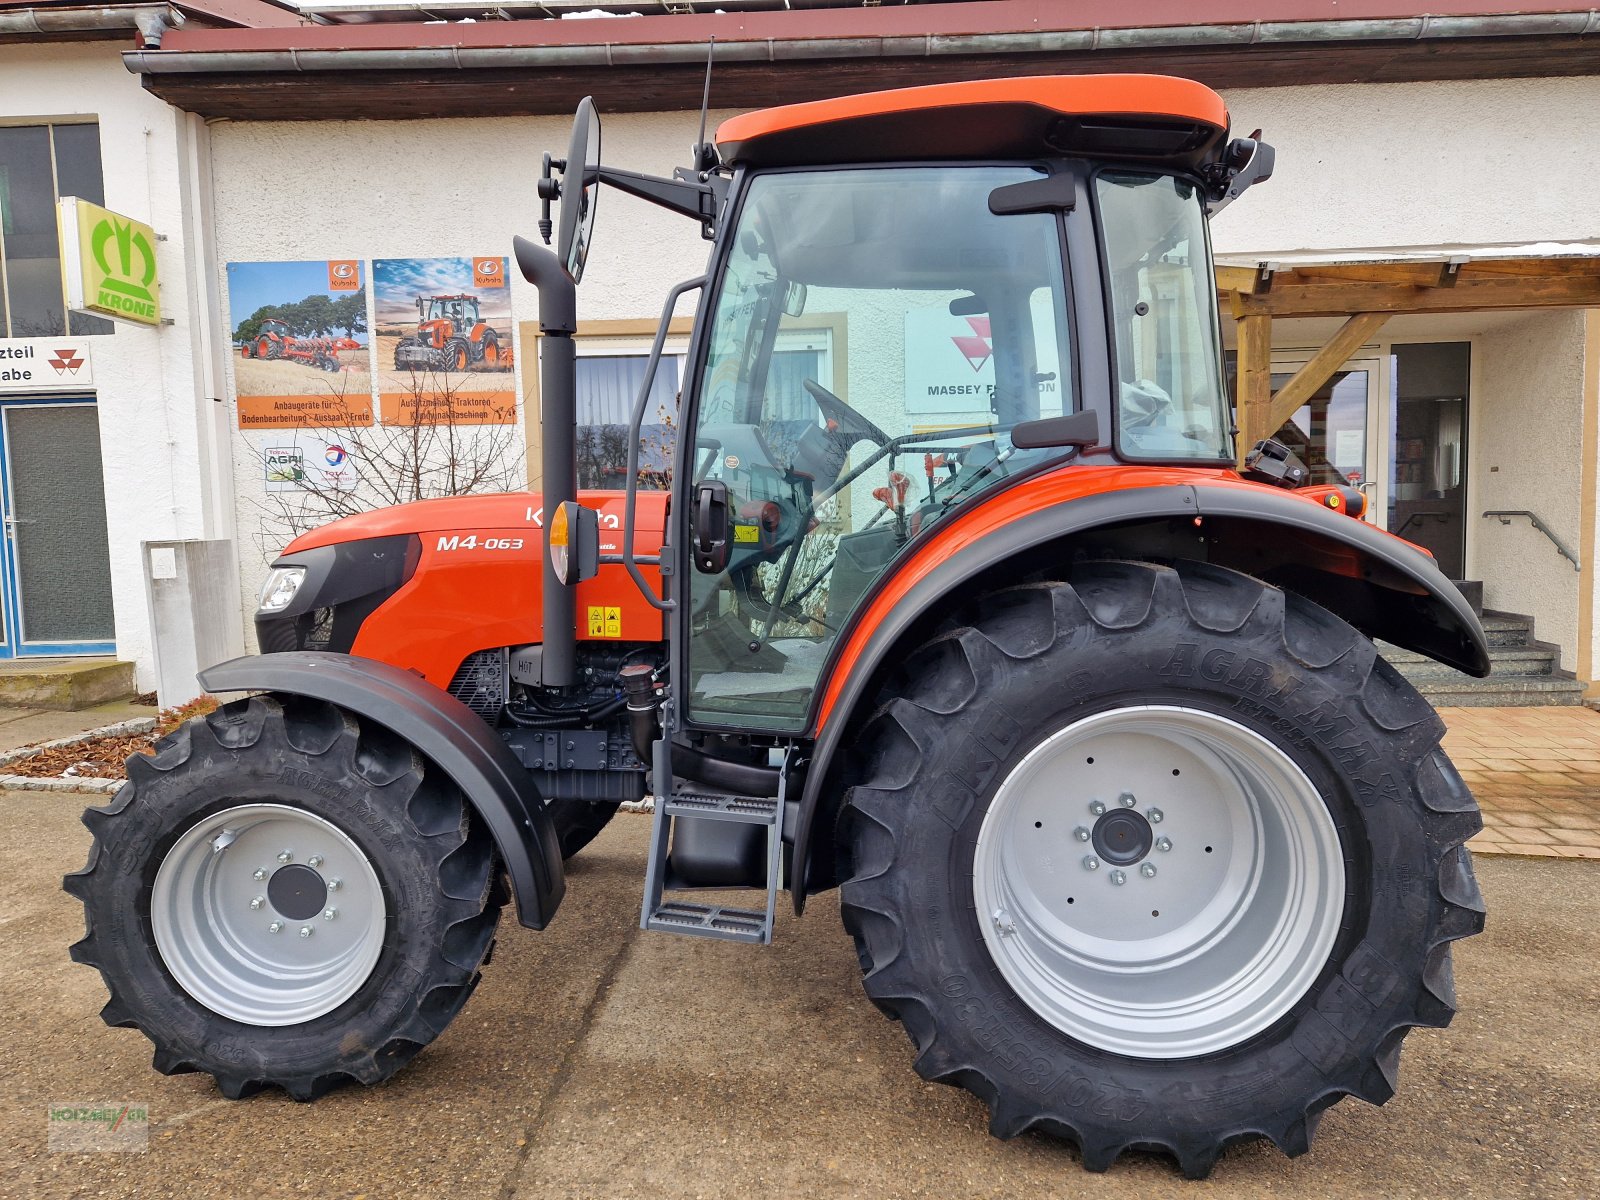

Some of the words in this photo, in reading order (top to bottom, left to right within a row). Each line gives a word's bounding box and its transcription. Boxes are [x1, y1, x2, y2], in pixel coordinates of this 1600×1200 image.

[97, 290, 156, 318] KRONE
[927, 384, 981, 396] MASSEY
[274, 400, 320, 411] Anbaugeräte
[241, 413, 307, 424] Bodenbearbeitung
[436, 535, 524, 551] M4-063
